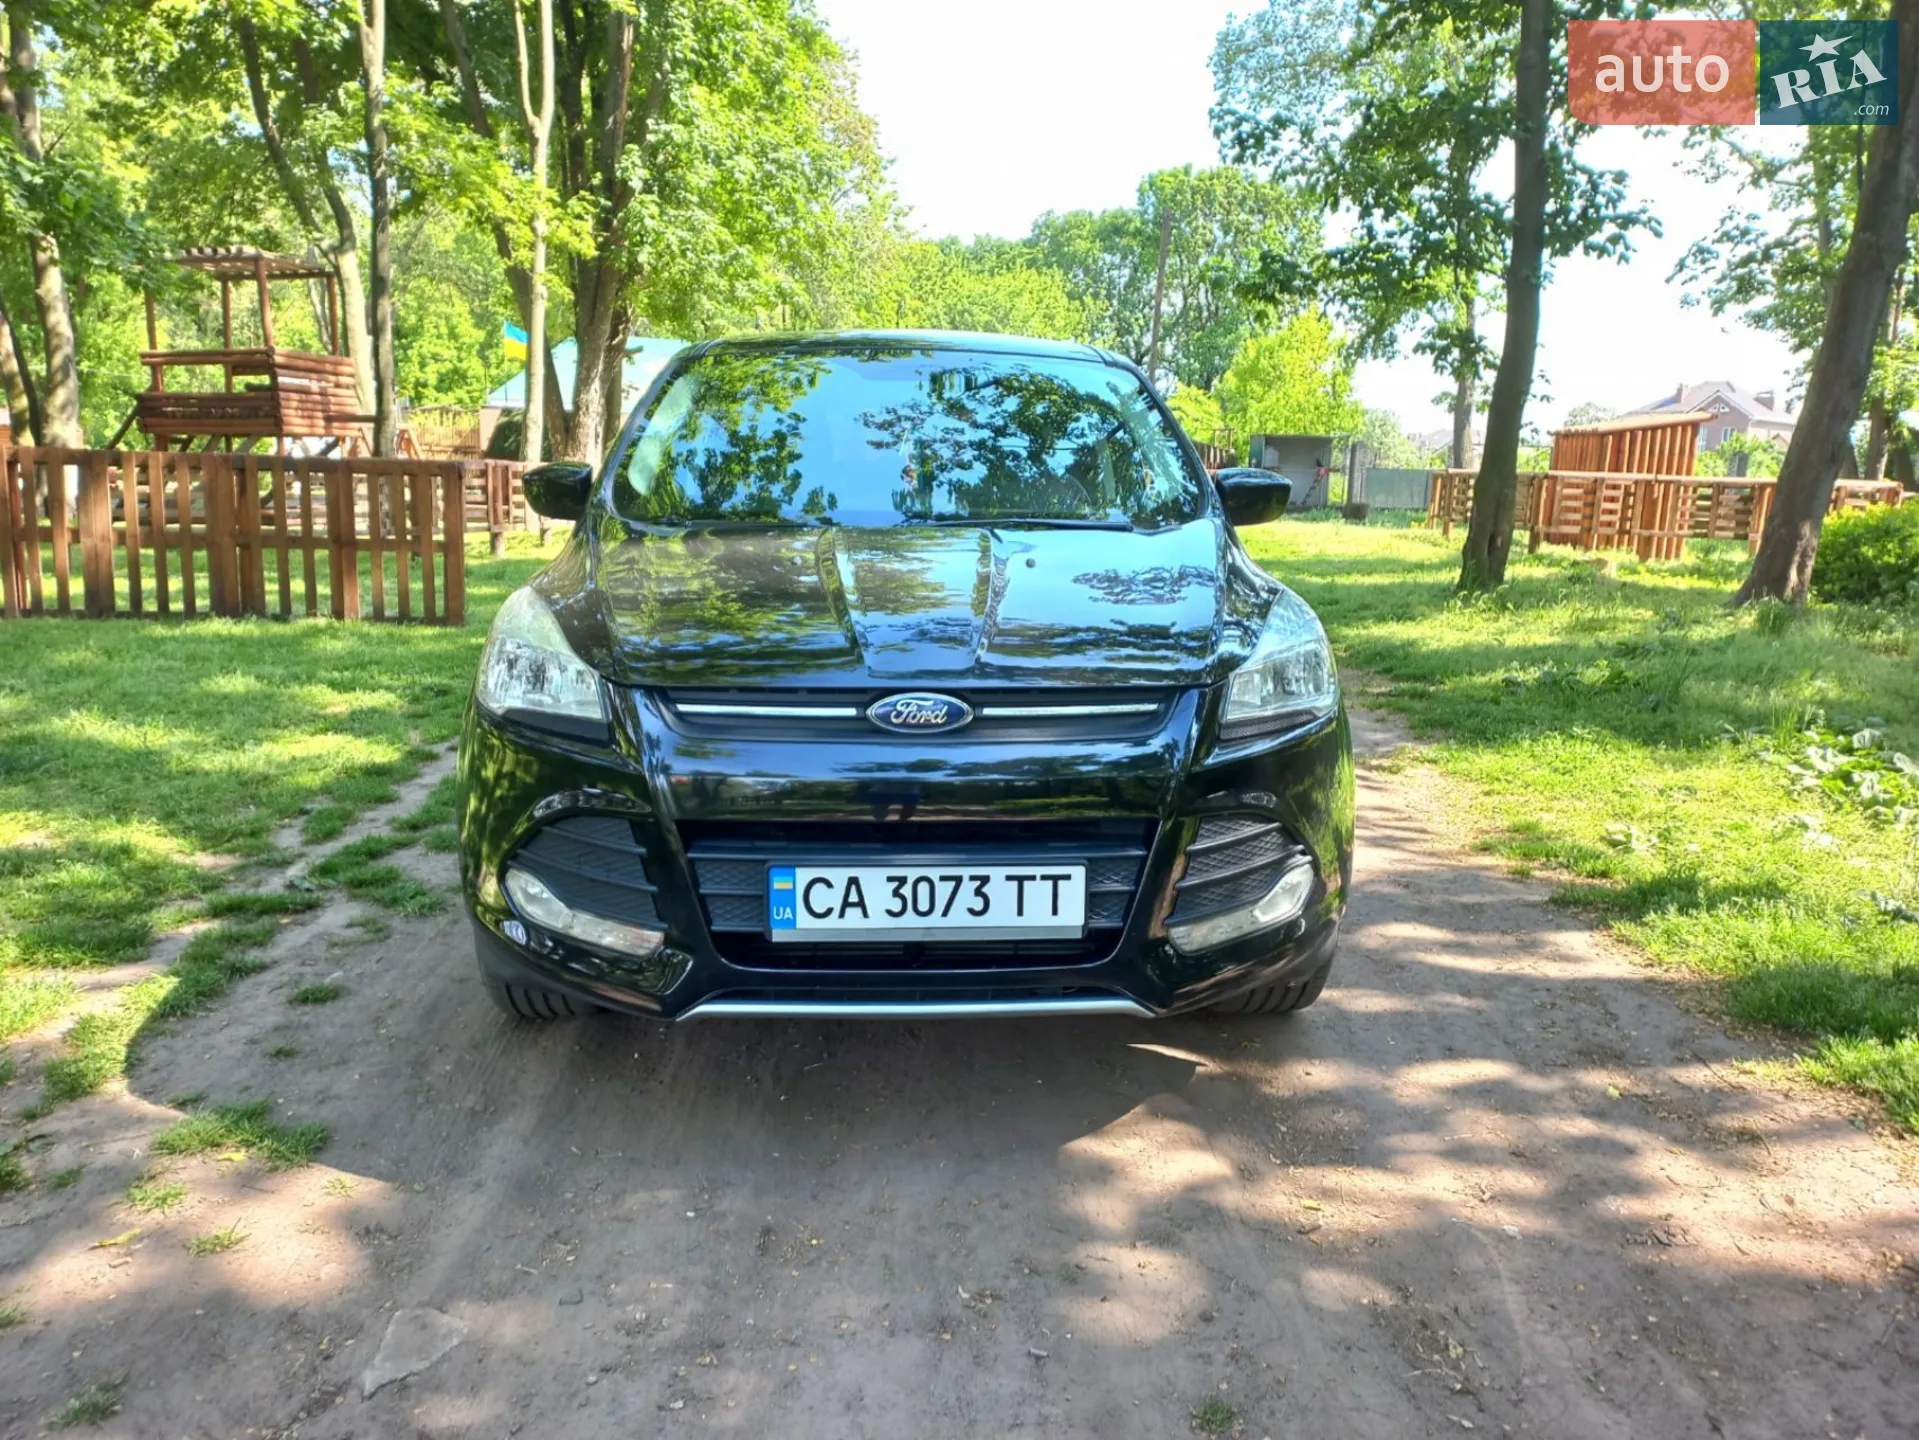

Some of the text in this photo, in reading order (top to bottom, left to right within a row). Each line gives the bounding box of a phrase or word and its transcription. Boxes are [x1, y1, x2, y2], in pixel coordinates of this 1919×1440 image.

[890, 699, 949, 724] Ford
[802, 873, 1072, 919] CA 3073 TT
[773, 907, 793, 920] UA
